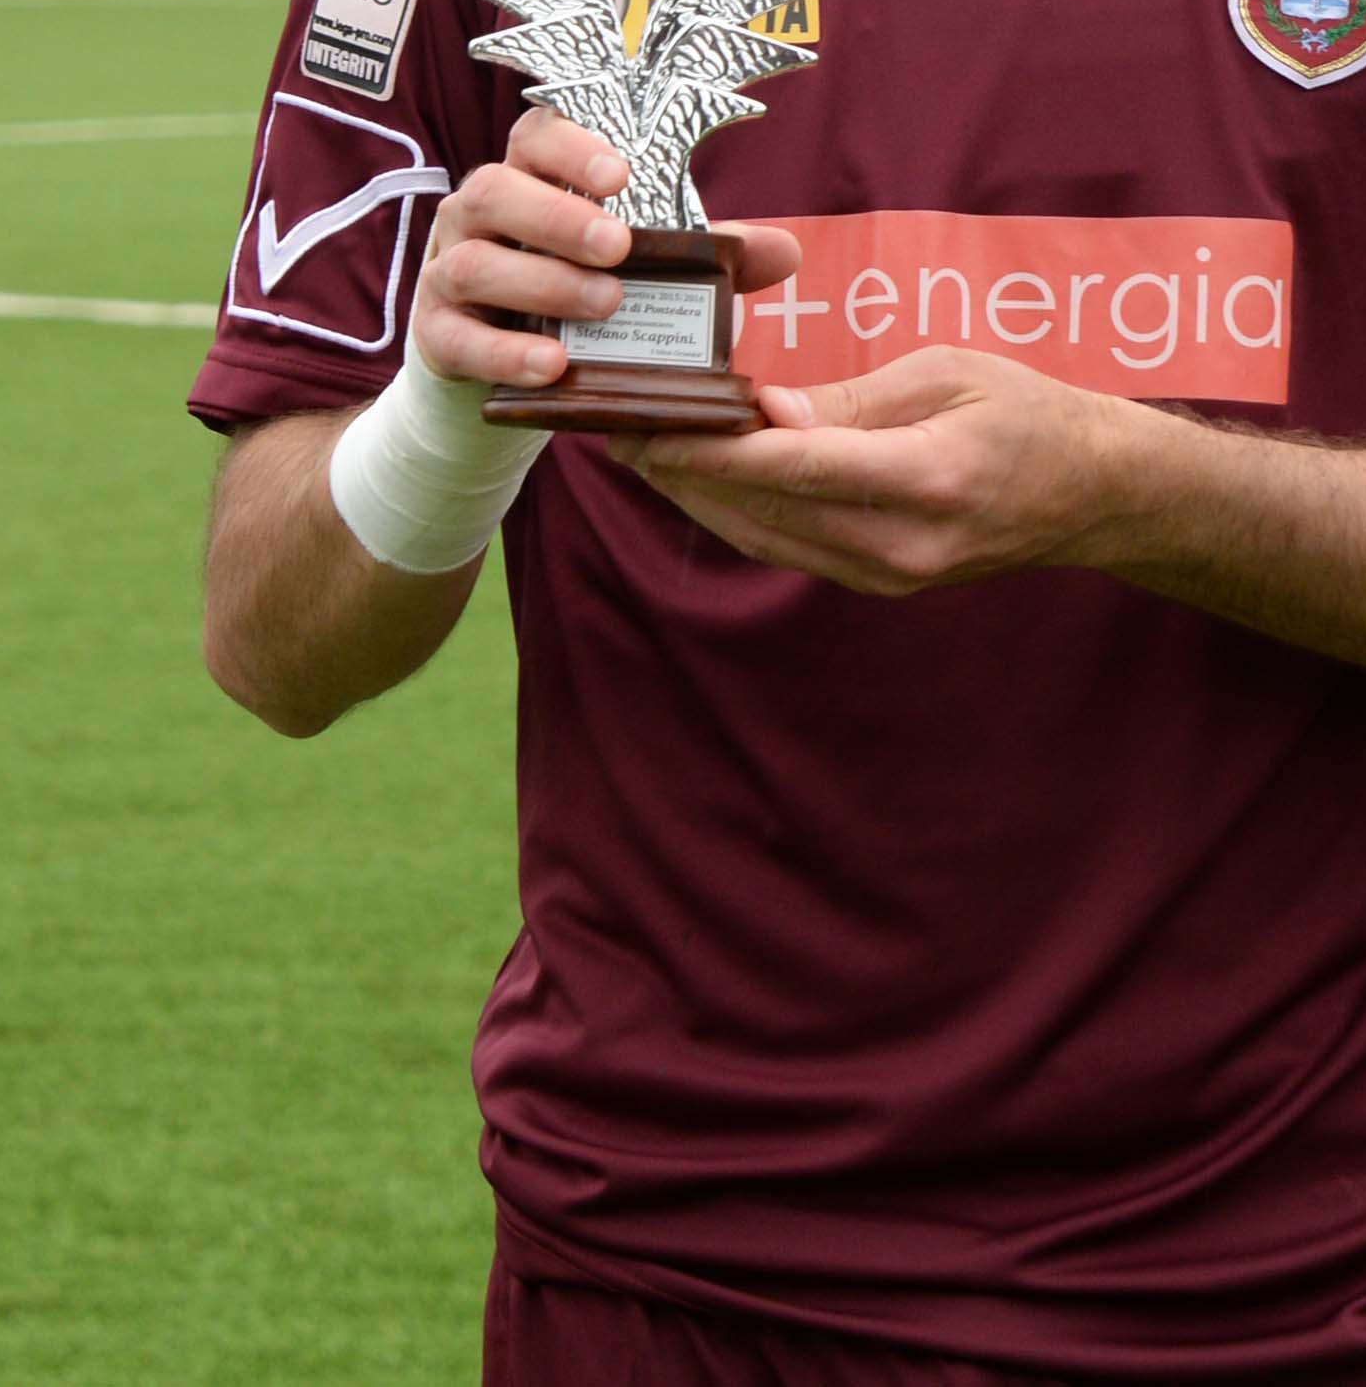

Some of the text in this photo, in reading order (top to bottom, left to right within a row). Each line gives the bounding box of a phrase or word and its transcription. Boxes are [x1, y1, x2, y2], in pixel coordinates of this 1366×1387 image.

[306, 39, 385, 83] INTEGRITY
[733, 245, 1284, 370] +energia
[574, 324, 629, 341] Stefano
